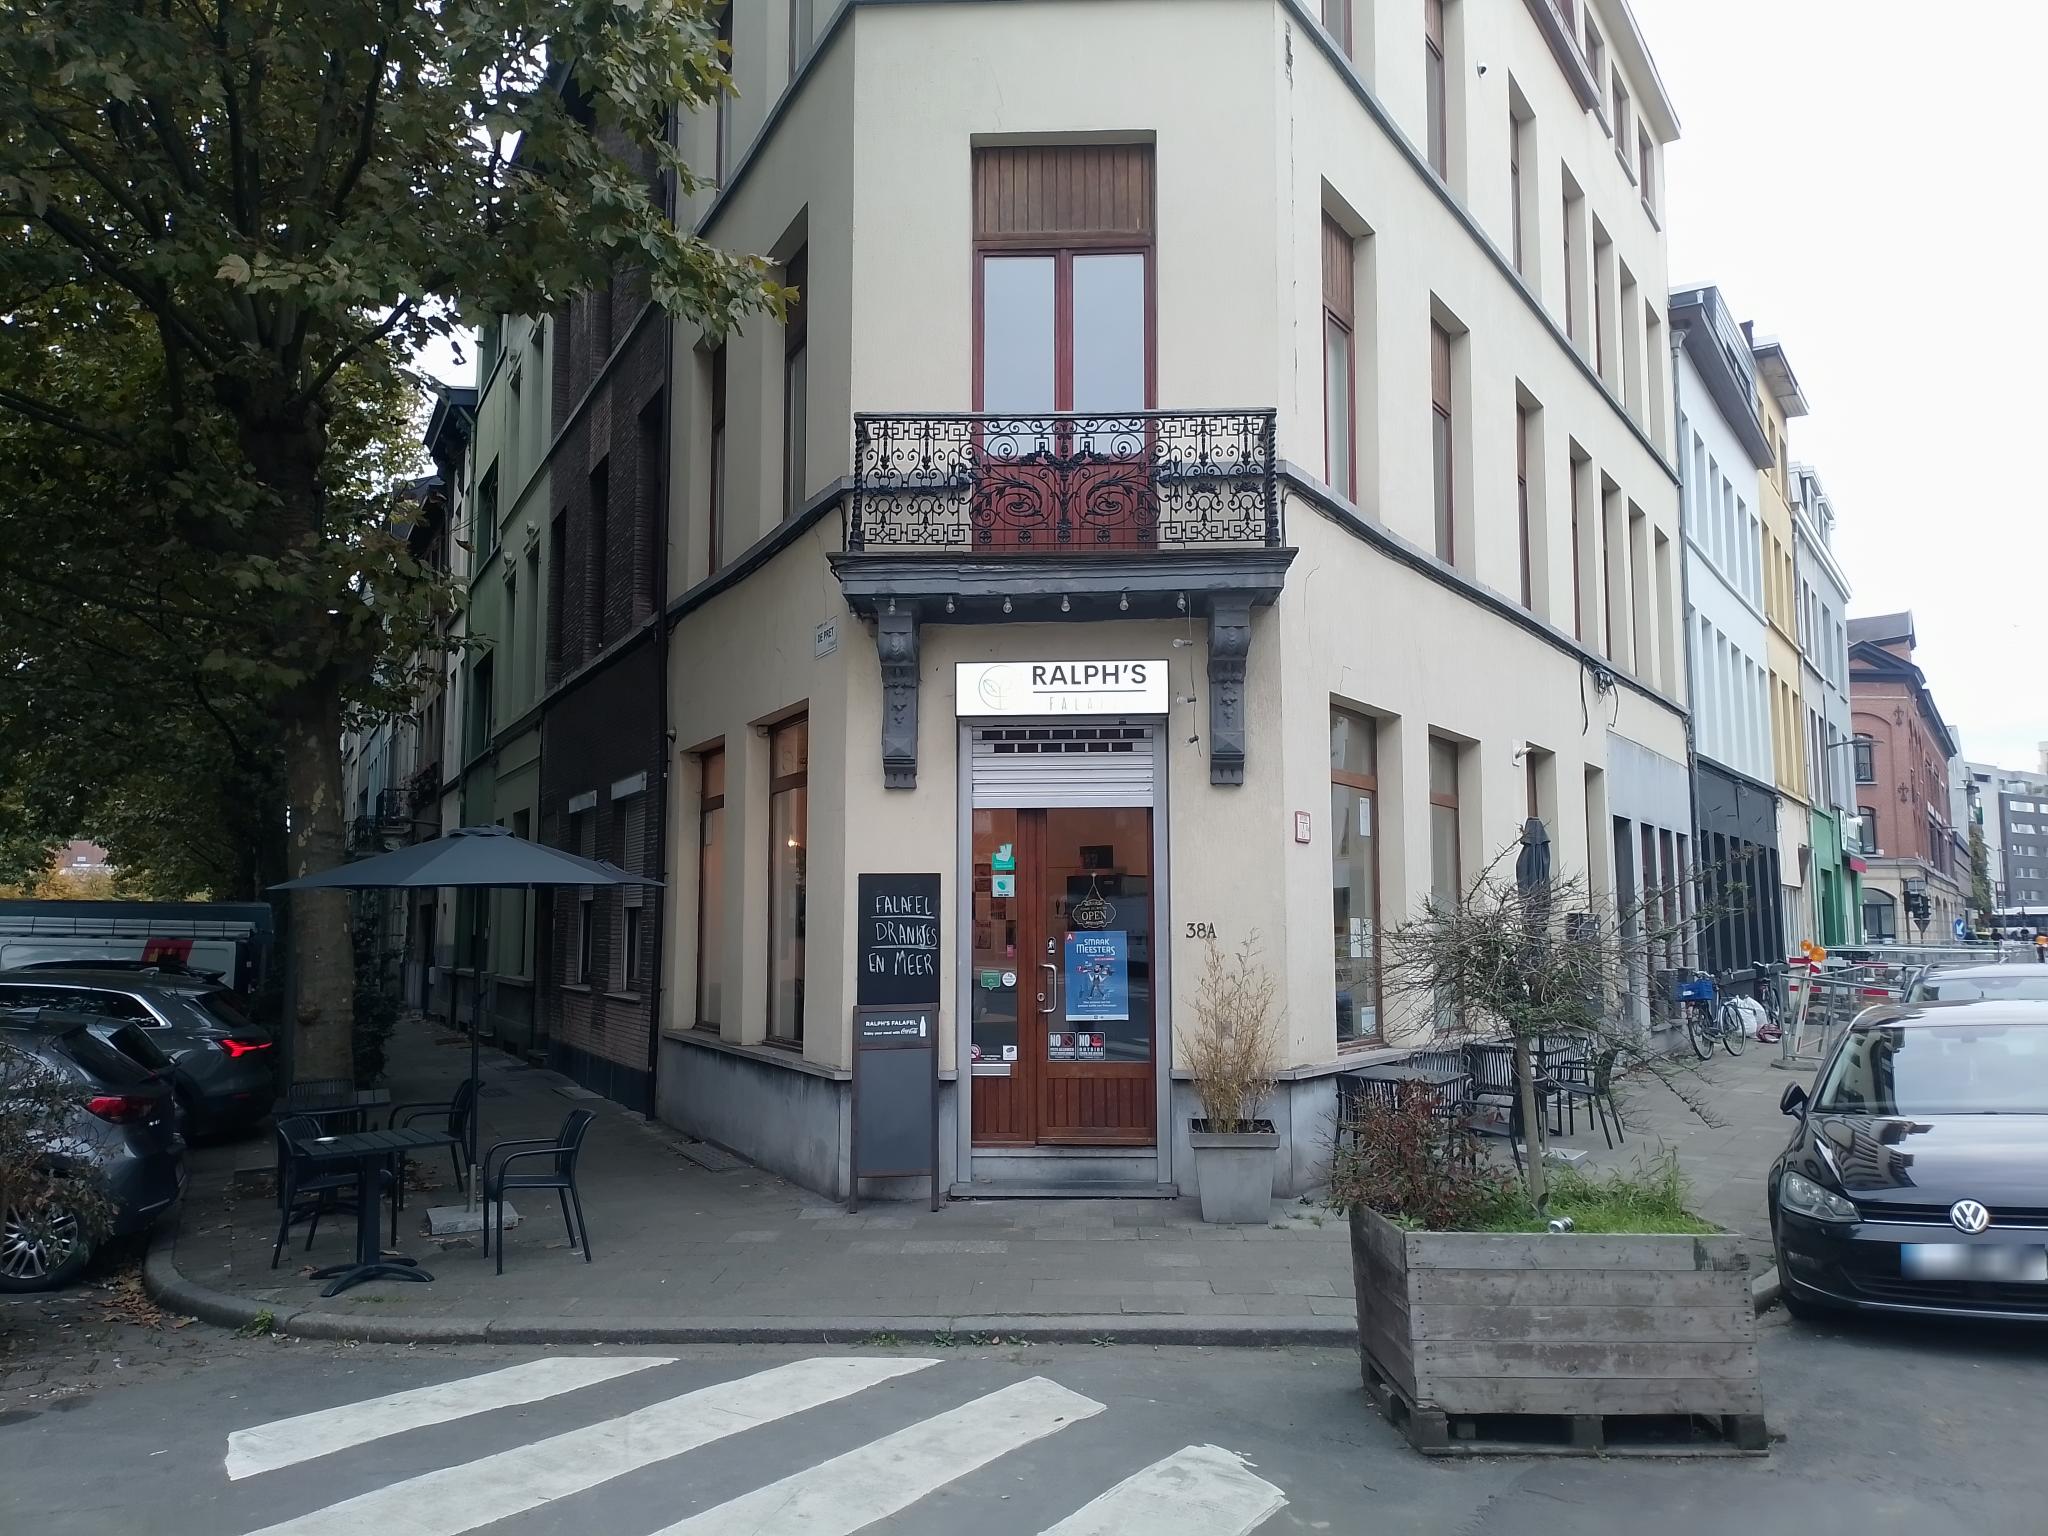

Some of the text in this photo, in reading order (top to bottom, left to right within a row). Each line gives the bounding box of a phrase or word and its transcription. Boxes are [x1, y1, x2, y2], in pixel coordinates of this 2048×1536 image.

[1032, 663, 1147, 686] RALPH'S
[875, 895, 932, 915] FALAFEL
[1081, 910, 1107, 921] OPEN
[1185, 922, 1217, 939] 38A
[1084, 938, 1110, 946] SMAAK
[1076, 944, 1116, 956] MEESTERS
[868, 950, 934, 976] EN MEER
[865, 1019, 918, 1028] RALPH'S FALAFEL
[1050, 1034, 1061, 1047] NO
[1079, 1034, 1090, 1047] NO
